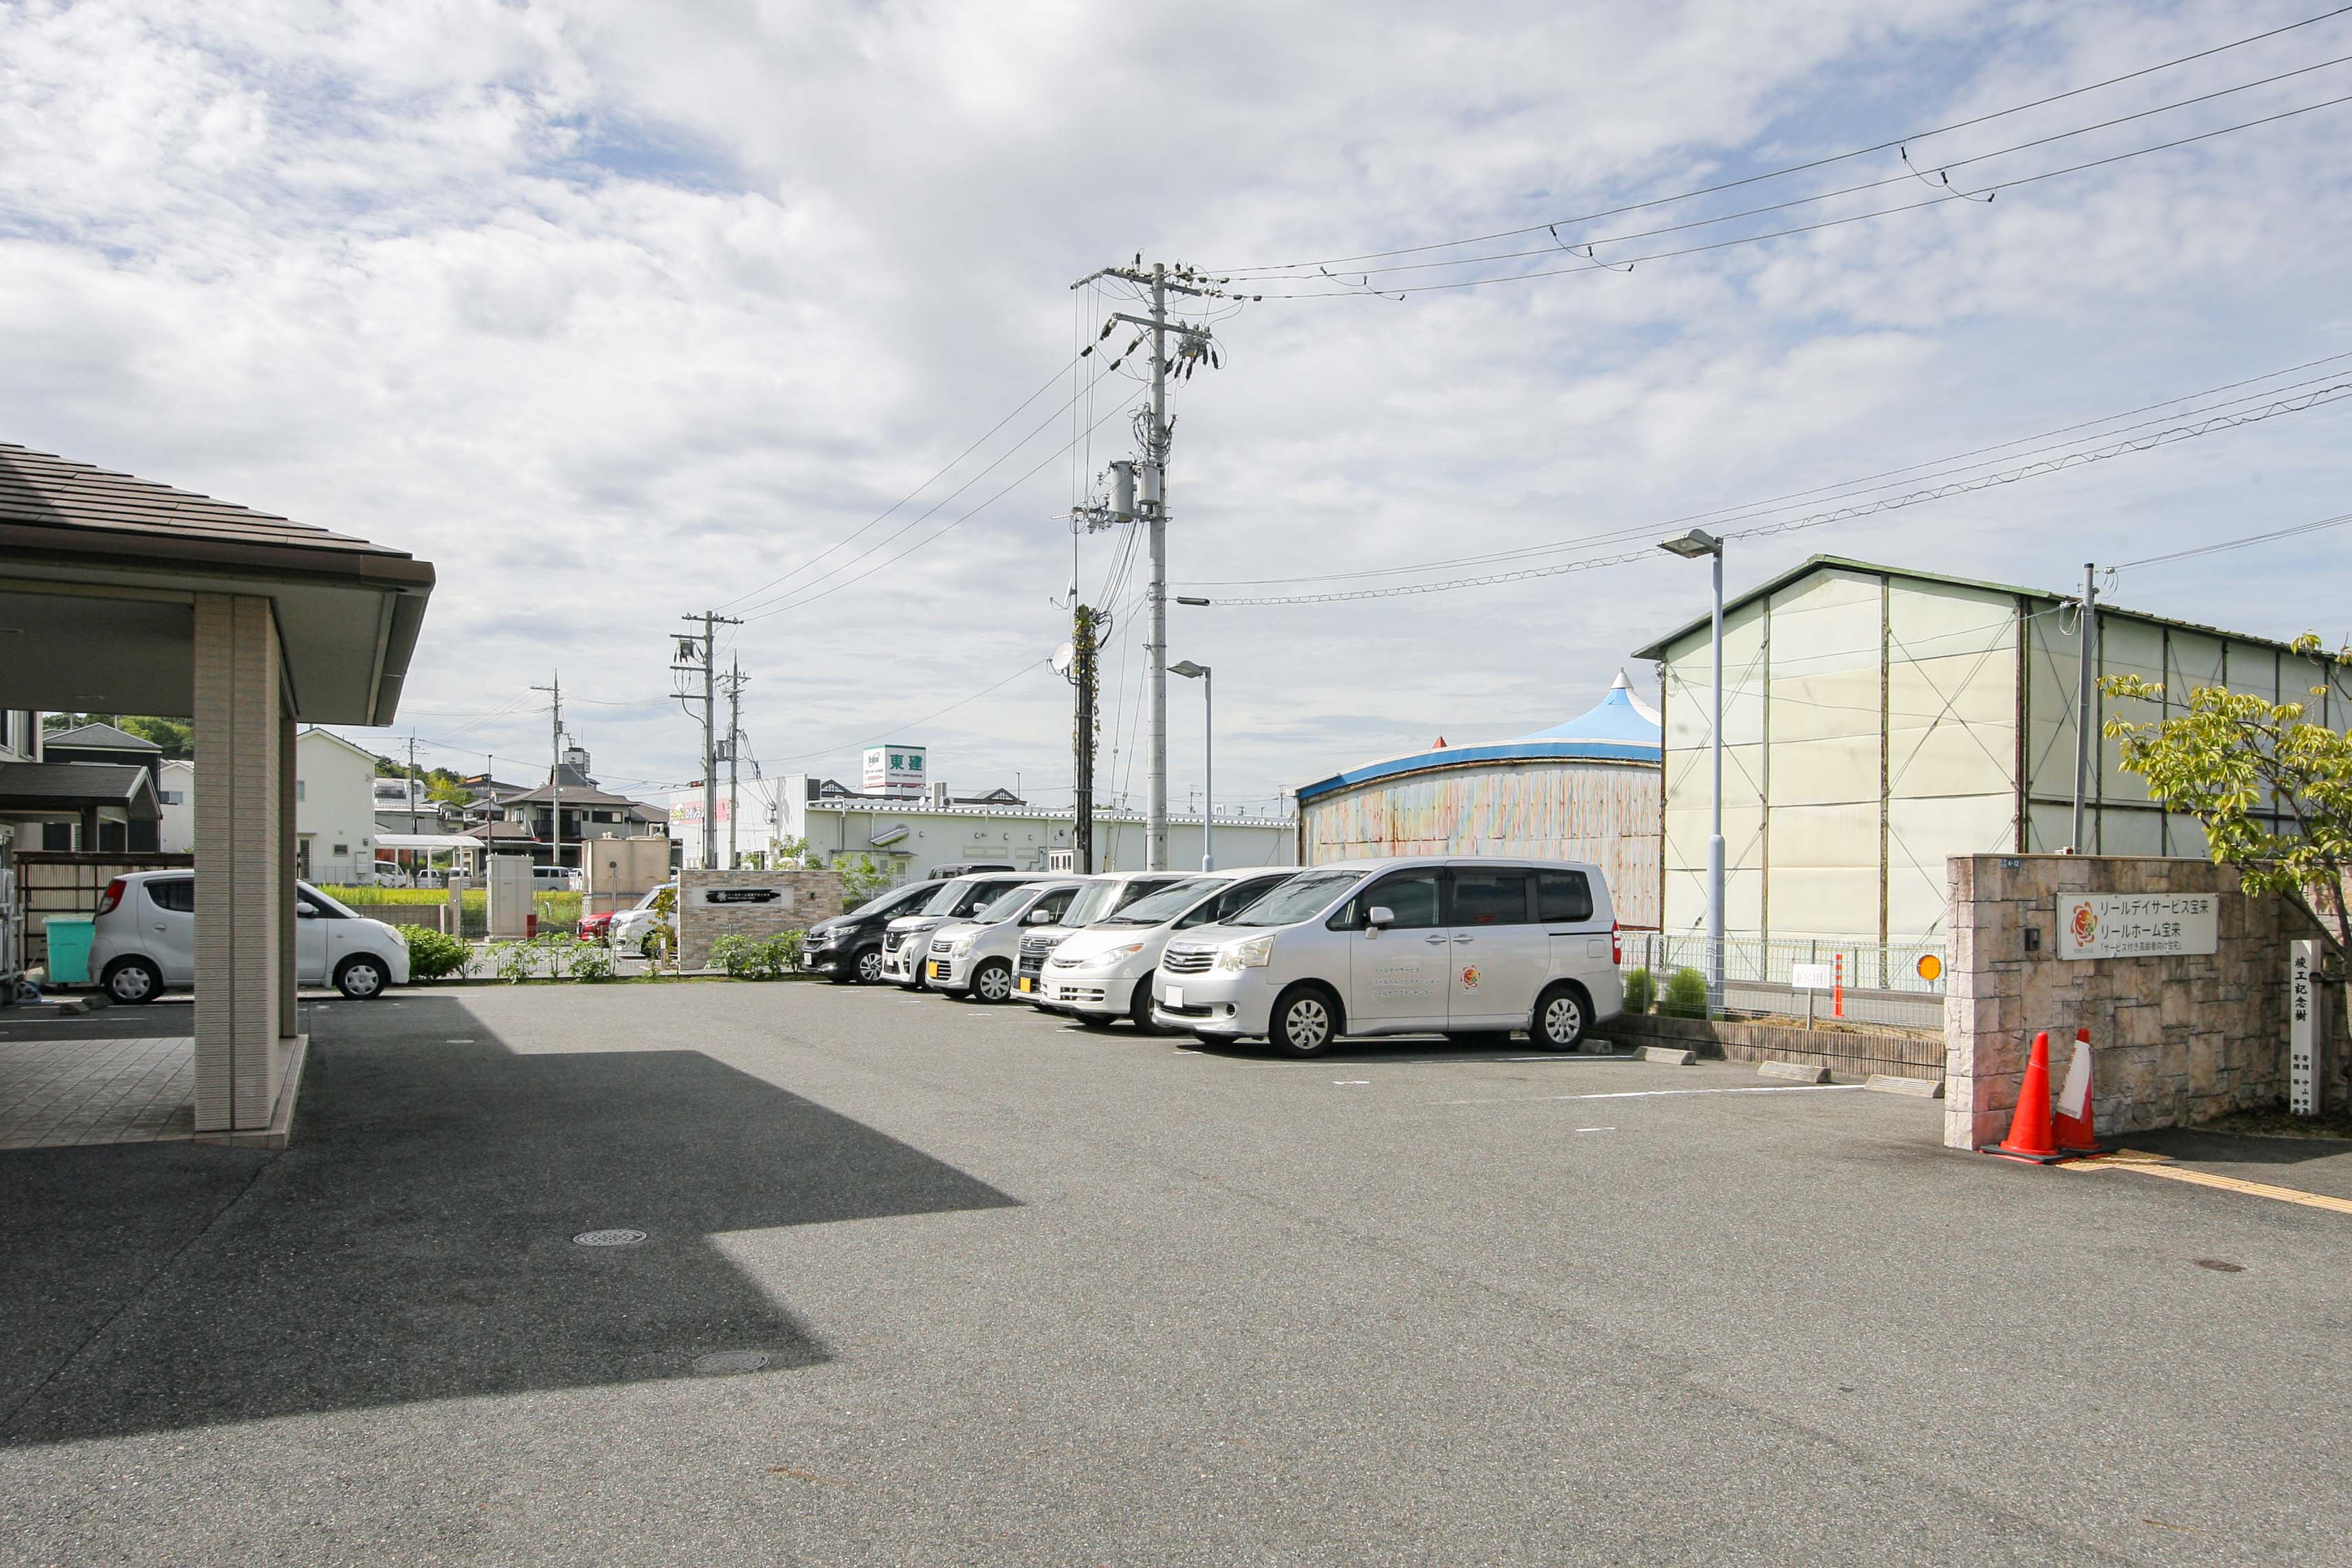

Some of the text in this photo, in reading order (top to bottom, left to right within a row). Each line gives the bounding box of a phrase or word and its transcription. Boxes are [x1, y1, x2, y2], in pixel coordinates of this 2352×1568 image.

[889, 754, 922, 770] 東建
[2100, 899, 2208, 916] リールデイサービス宝来
[2101, 922, 2181, 939] リールホーム宝来
[2294, 956, 2307, 1021] 竣工記念樹
